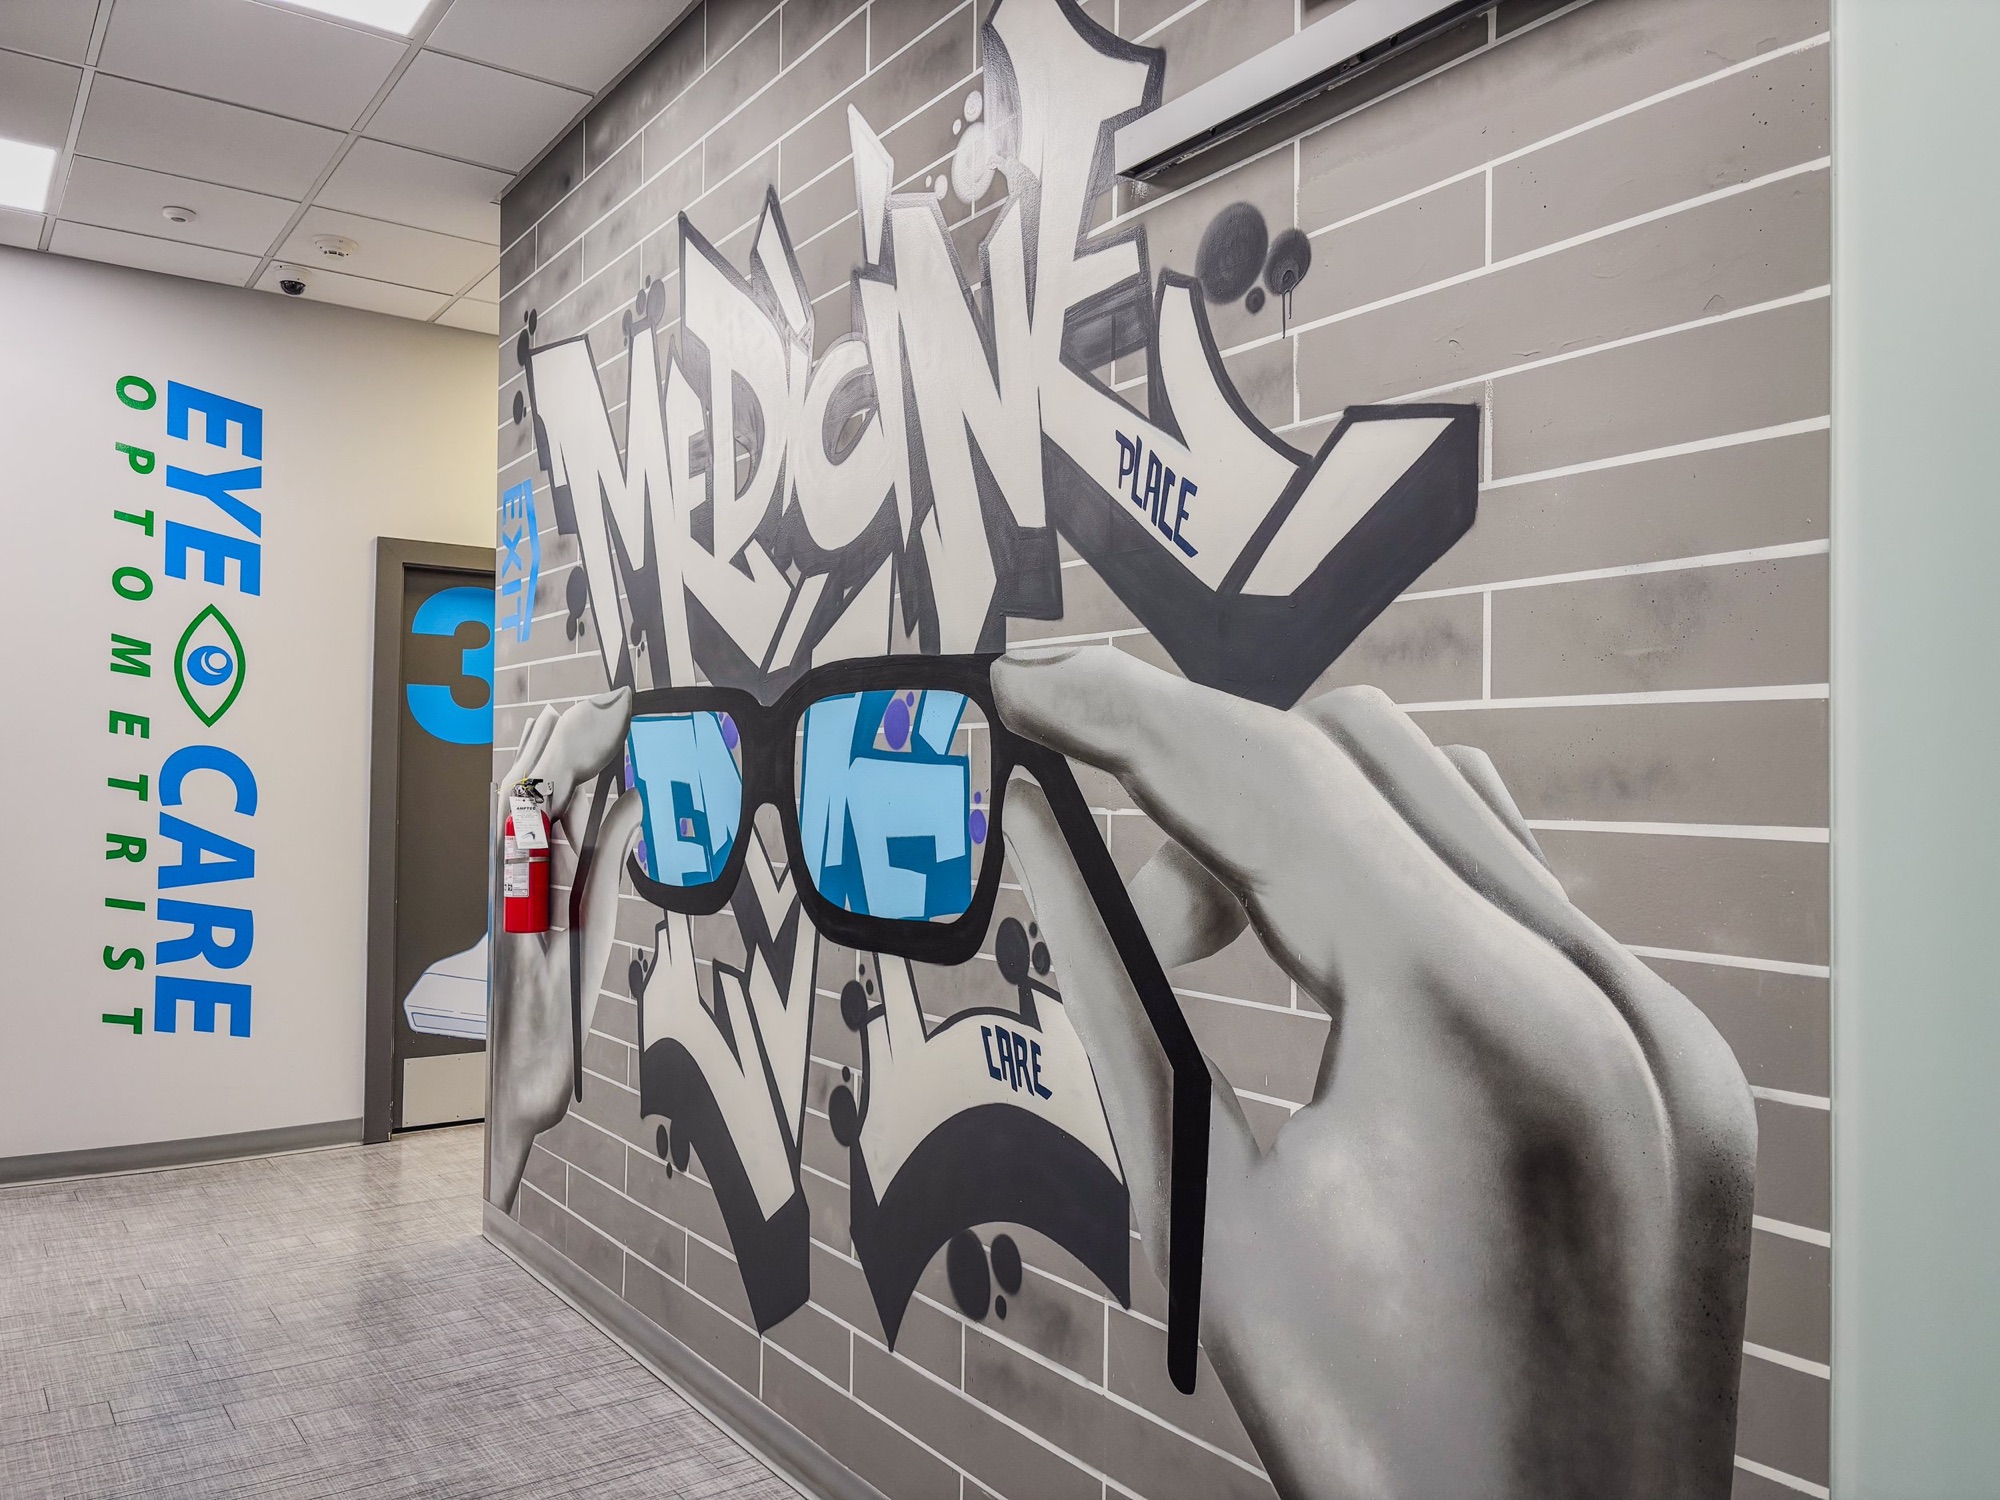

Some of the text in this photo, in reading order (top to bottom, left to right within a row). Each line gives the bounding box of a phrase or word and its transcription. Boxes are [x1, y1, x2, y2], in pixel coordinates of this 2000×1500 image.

[501, 483, 523, 643] EXIT
[1115, 429, 1198, 558] PLACE
[102, 375, 157, 1035] OPTOMETRIST
[153, 380, 263, 1037] EYE CARE
[406, 586, 495, 745] 3
[981, 1025, 1053, 1100] CARE
